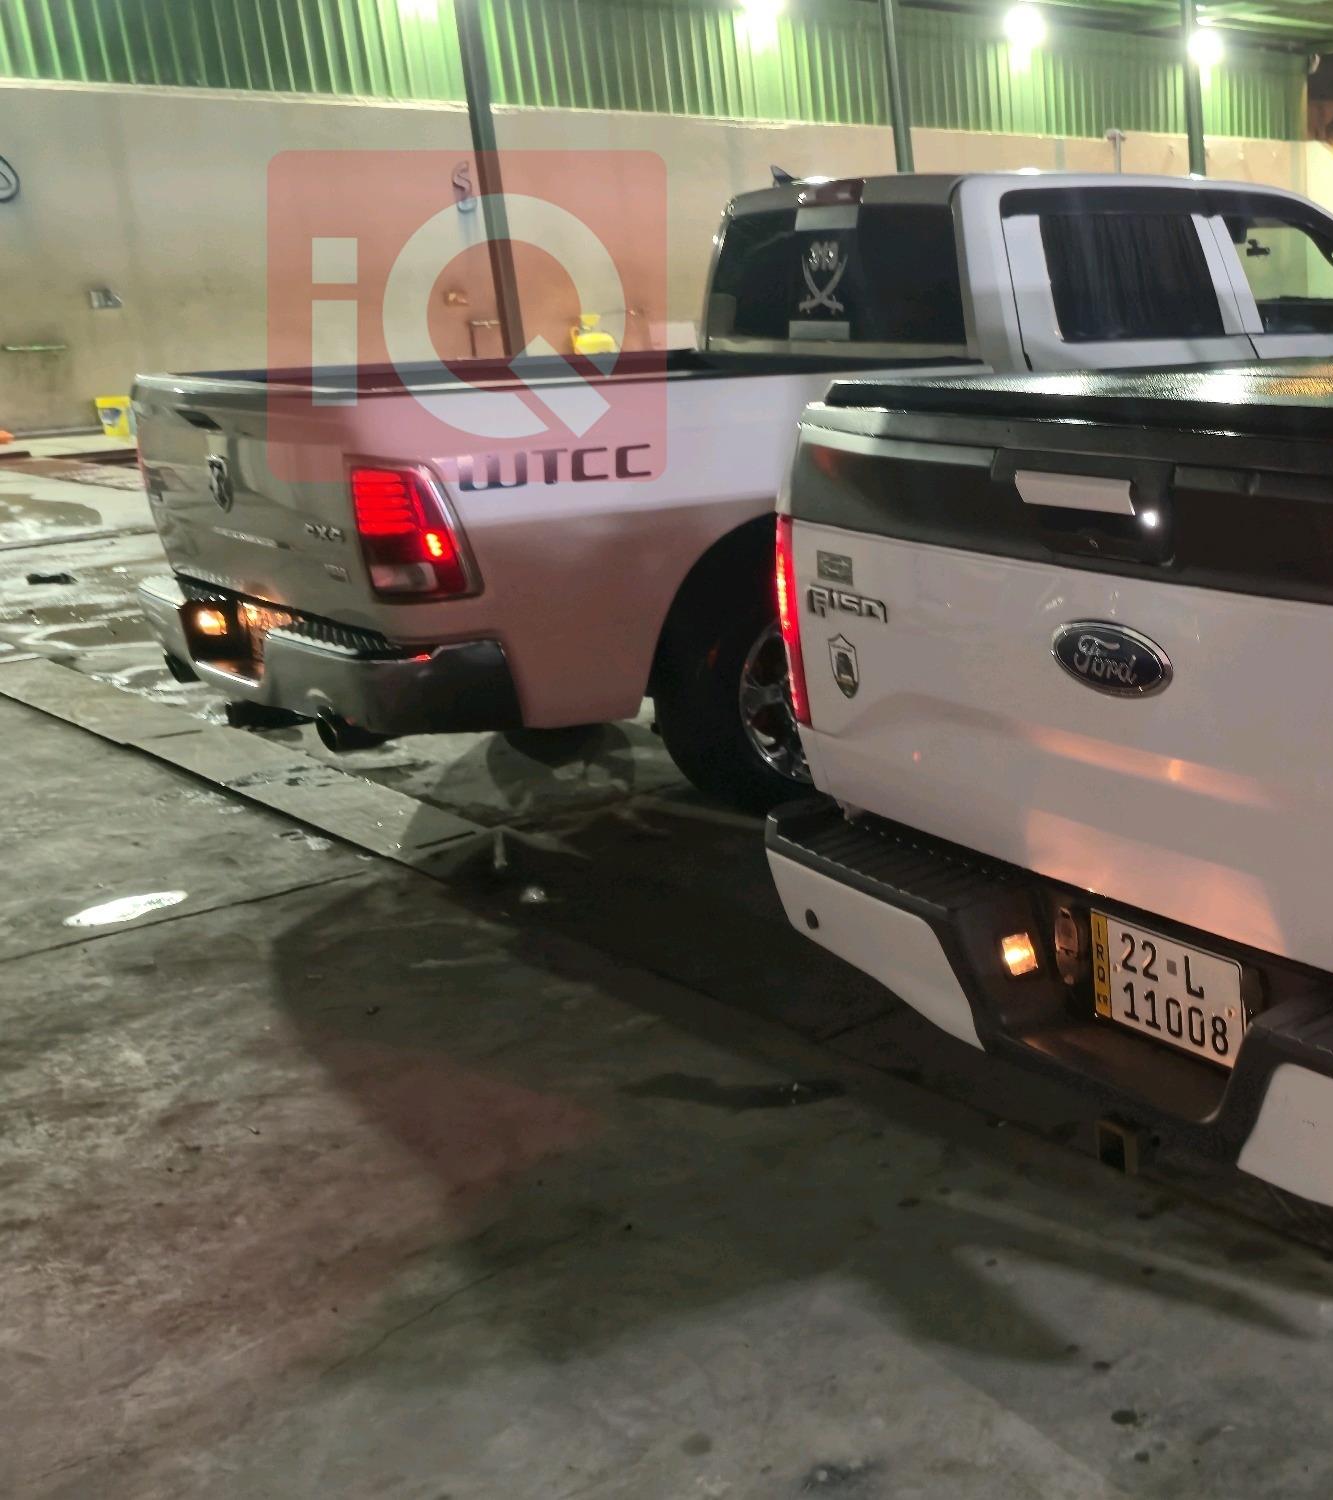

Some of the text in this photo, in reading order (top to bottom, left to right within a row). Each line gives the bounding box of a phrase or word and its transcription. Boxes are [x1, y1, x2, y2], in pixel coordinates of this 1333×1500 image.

[457, 444, 652, 491] WTCC
[1073, 634, 1138, 684] Ford
[1120, 932, 1205, 1000] 22 L
[1122, 981, 1229, 1056] 11008
